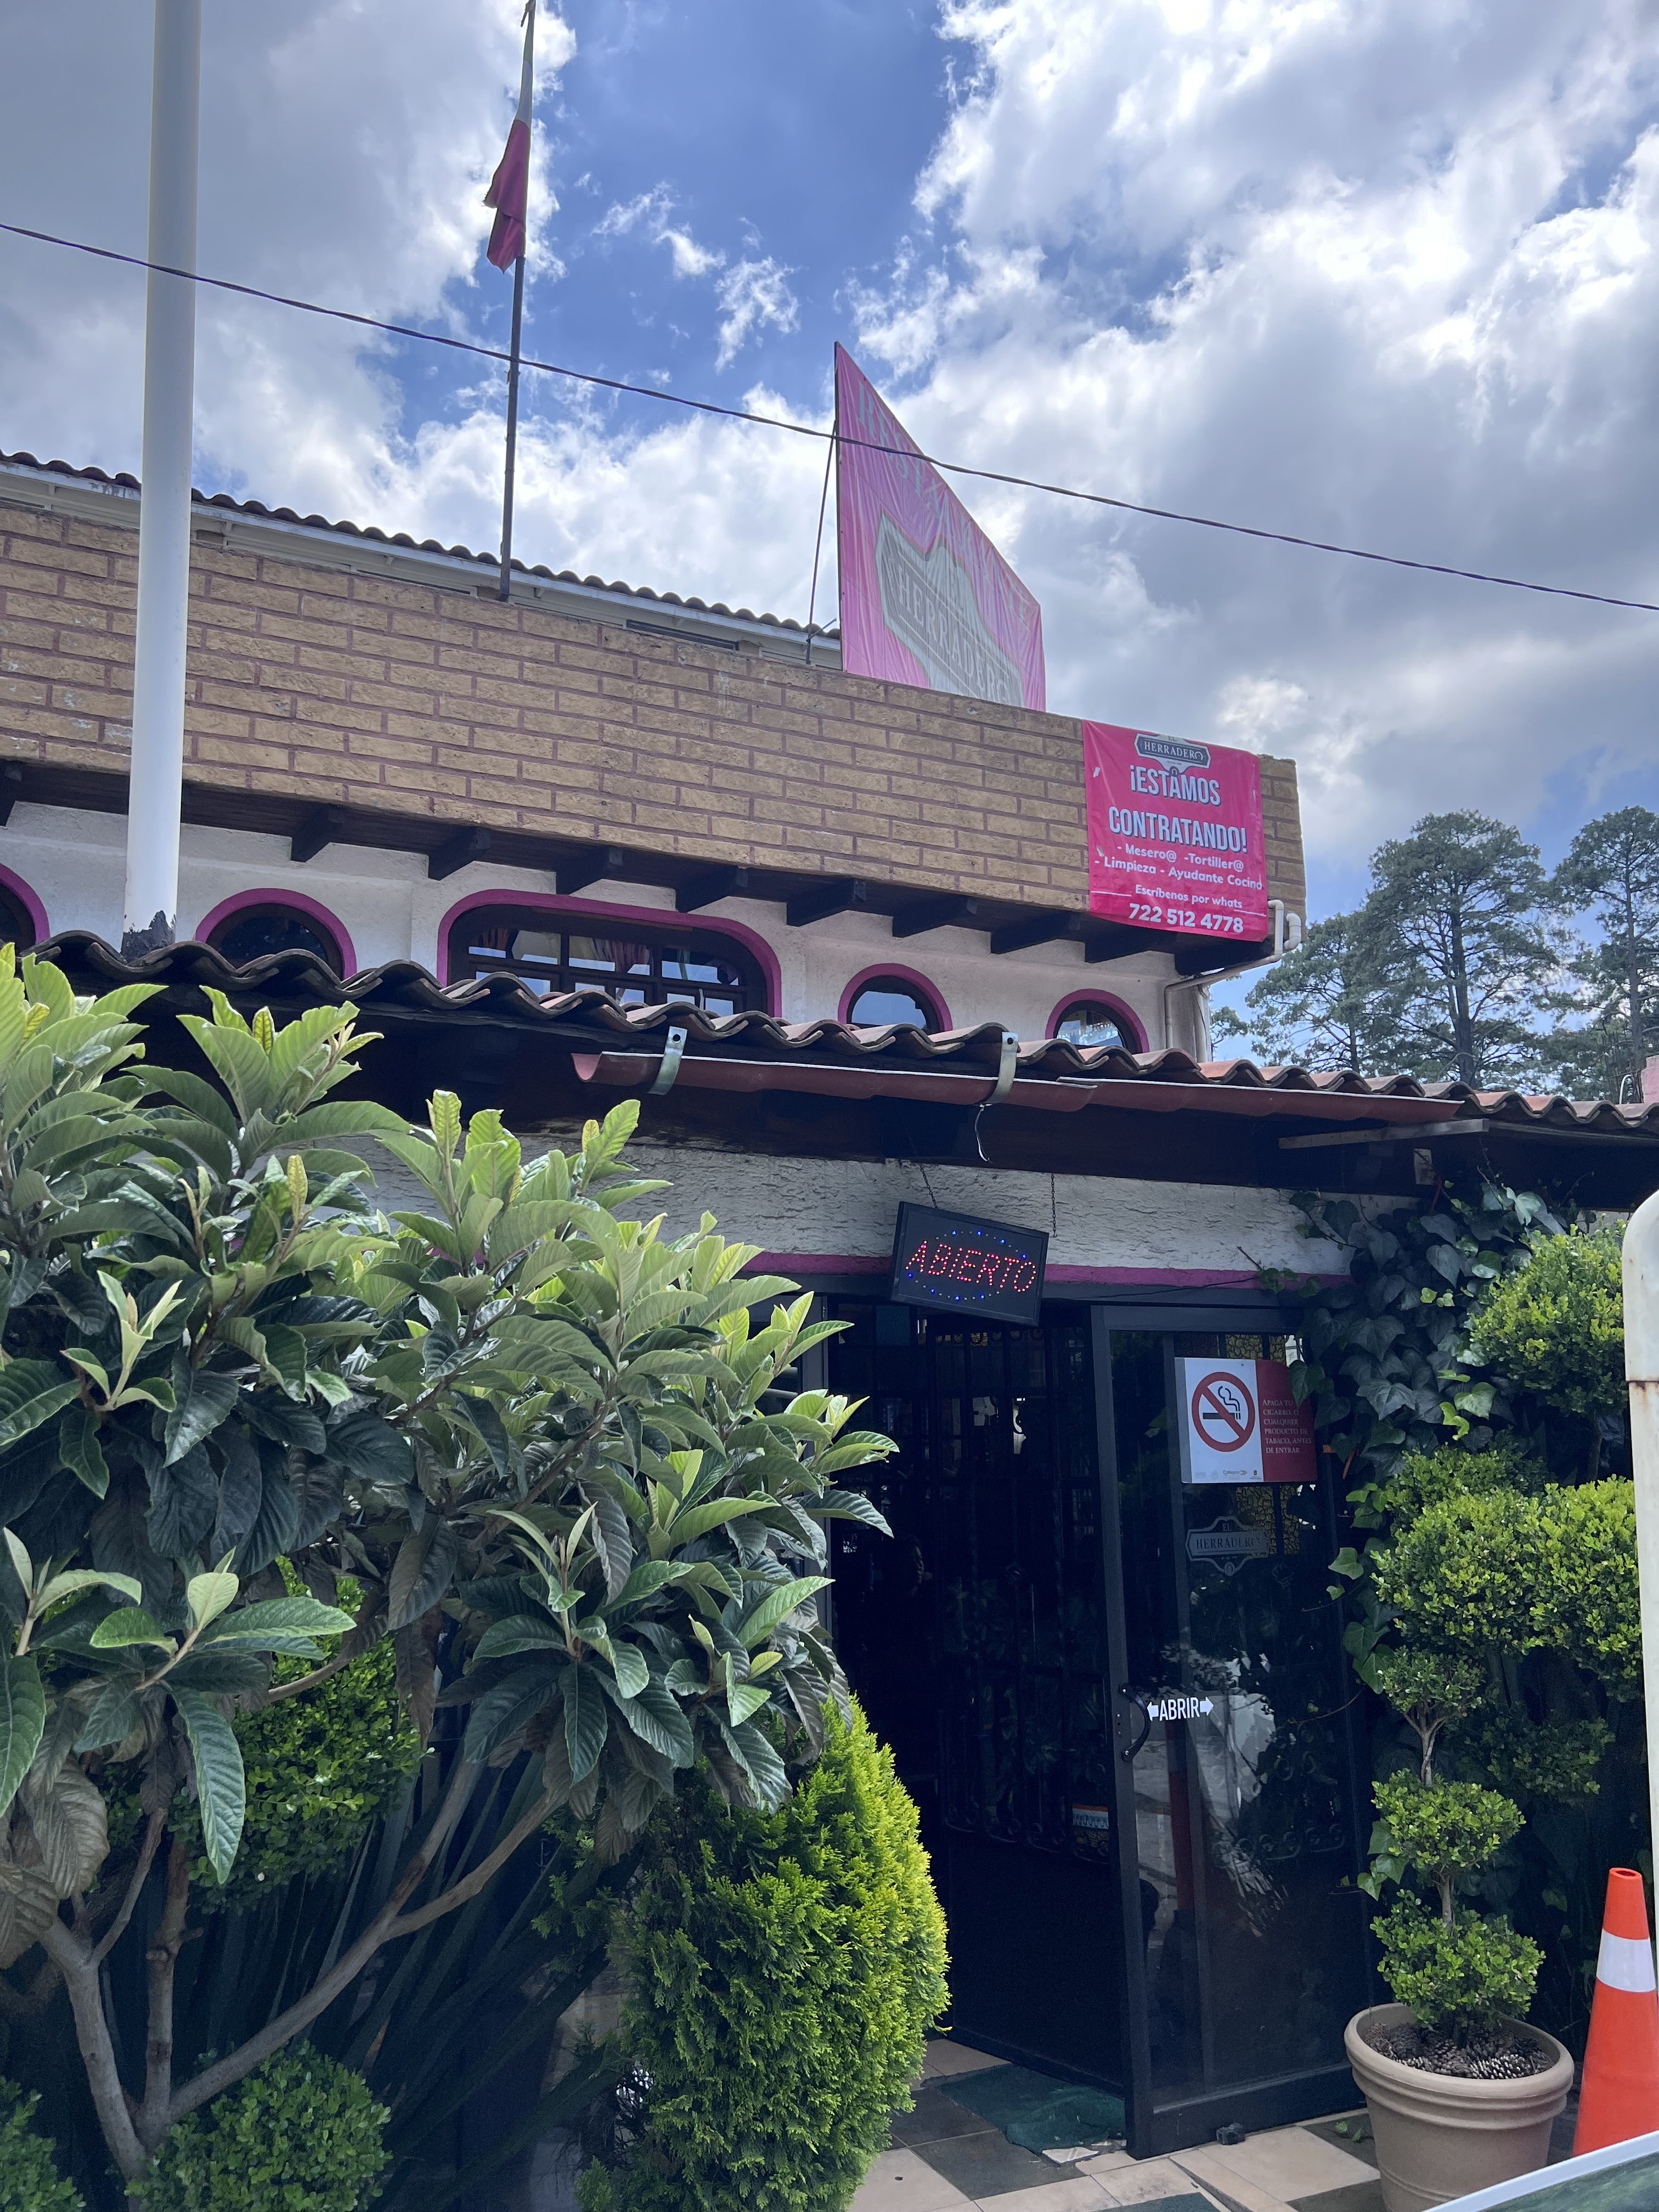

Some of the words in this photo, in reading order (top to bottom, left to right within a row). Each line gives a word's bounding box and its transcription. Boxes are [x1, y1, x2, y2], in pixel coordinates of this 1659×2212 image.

[1144, 741, 1204, 760] HERRADERO
[1129, 765, 1222, 806] ¡ESTAMOS
[1109, 806, 1248, 854] CONTRATANDO!
[1125, 843, 1177, 863] Mesero@
[1104, 856, 1156, 874] Limpieza
[1168, 866, 1223, 884] Ayudante
[1135, 884, 1189, 902] Escríbenos
[1191, 894, 1209, 905] por
[1212, 896, 1243, 909] whats
[1128, 902, 1163, 923] 722
[1167, 909, 1196, 927] 512
[1200, 913, 1244, 933] 4778
[905, 1239, 1037, 1293] ABIERTO
[1263, 1418, 1299, 1426] CUALQUIER
[1222, 1523, 1232, 1532] EL
[1159, 1697, 1200, 1722] ABRIR
